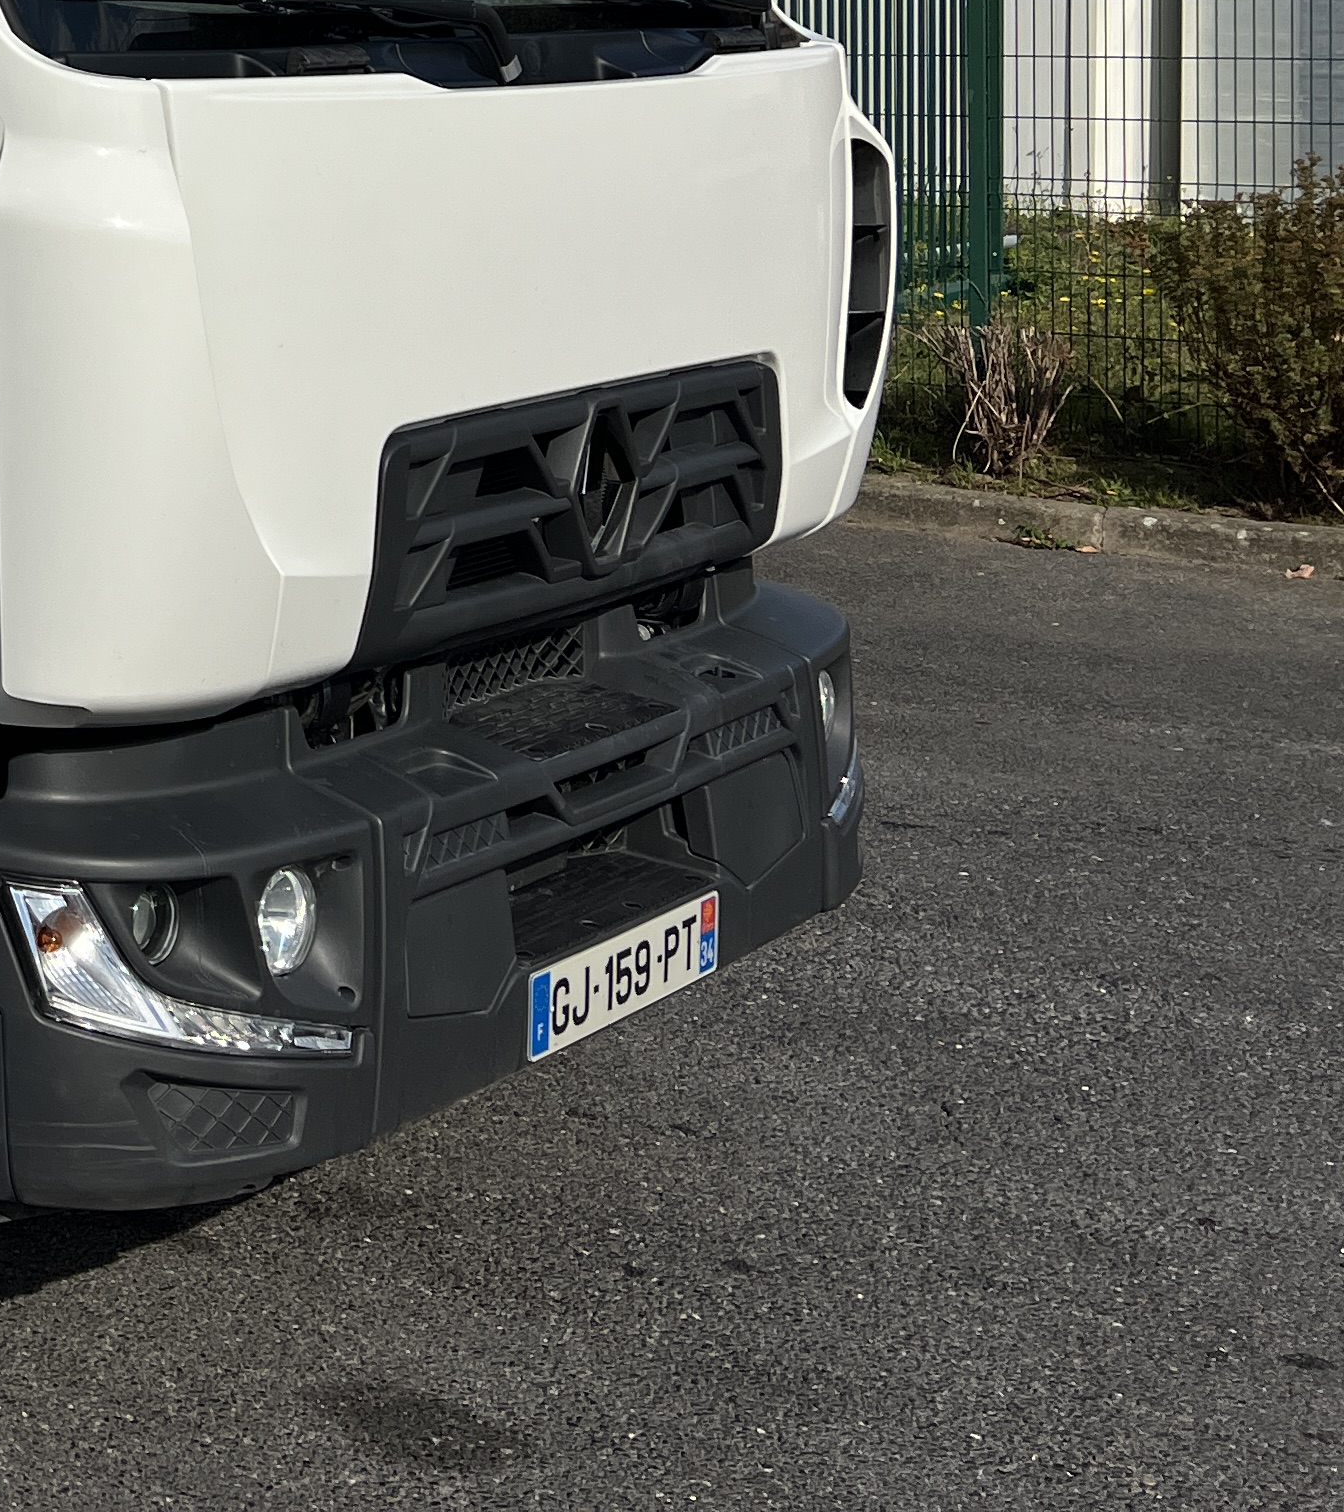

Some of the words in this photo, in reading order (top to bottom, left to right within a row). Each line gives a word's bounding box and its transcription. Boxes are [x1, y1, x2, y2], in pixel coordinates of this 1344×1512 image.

[537, 1022, 544, 1041] F
[552, 914, 697, 1035] GJ-159-PT
[700, 940, 713, 967] 34
